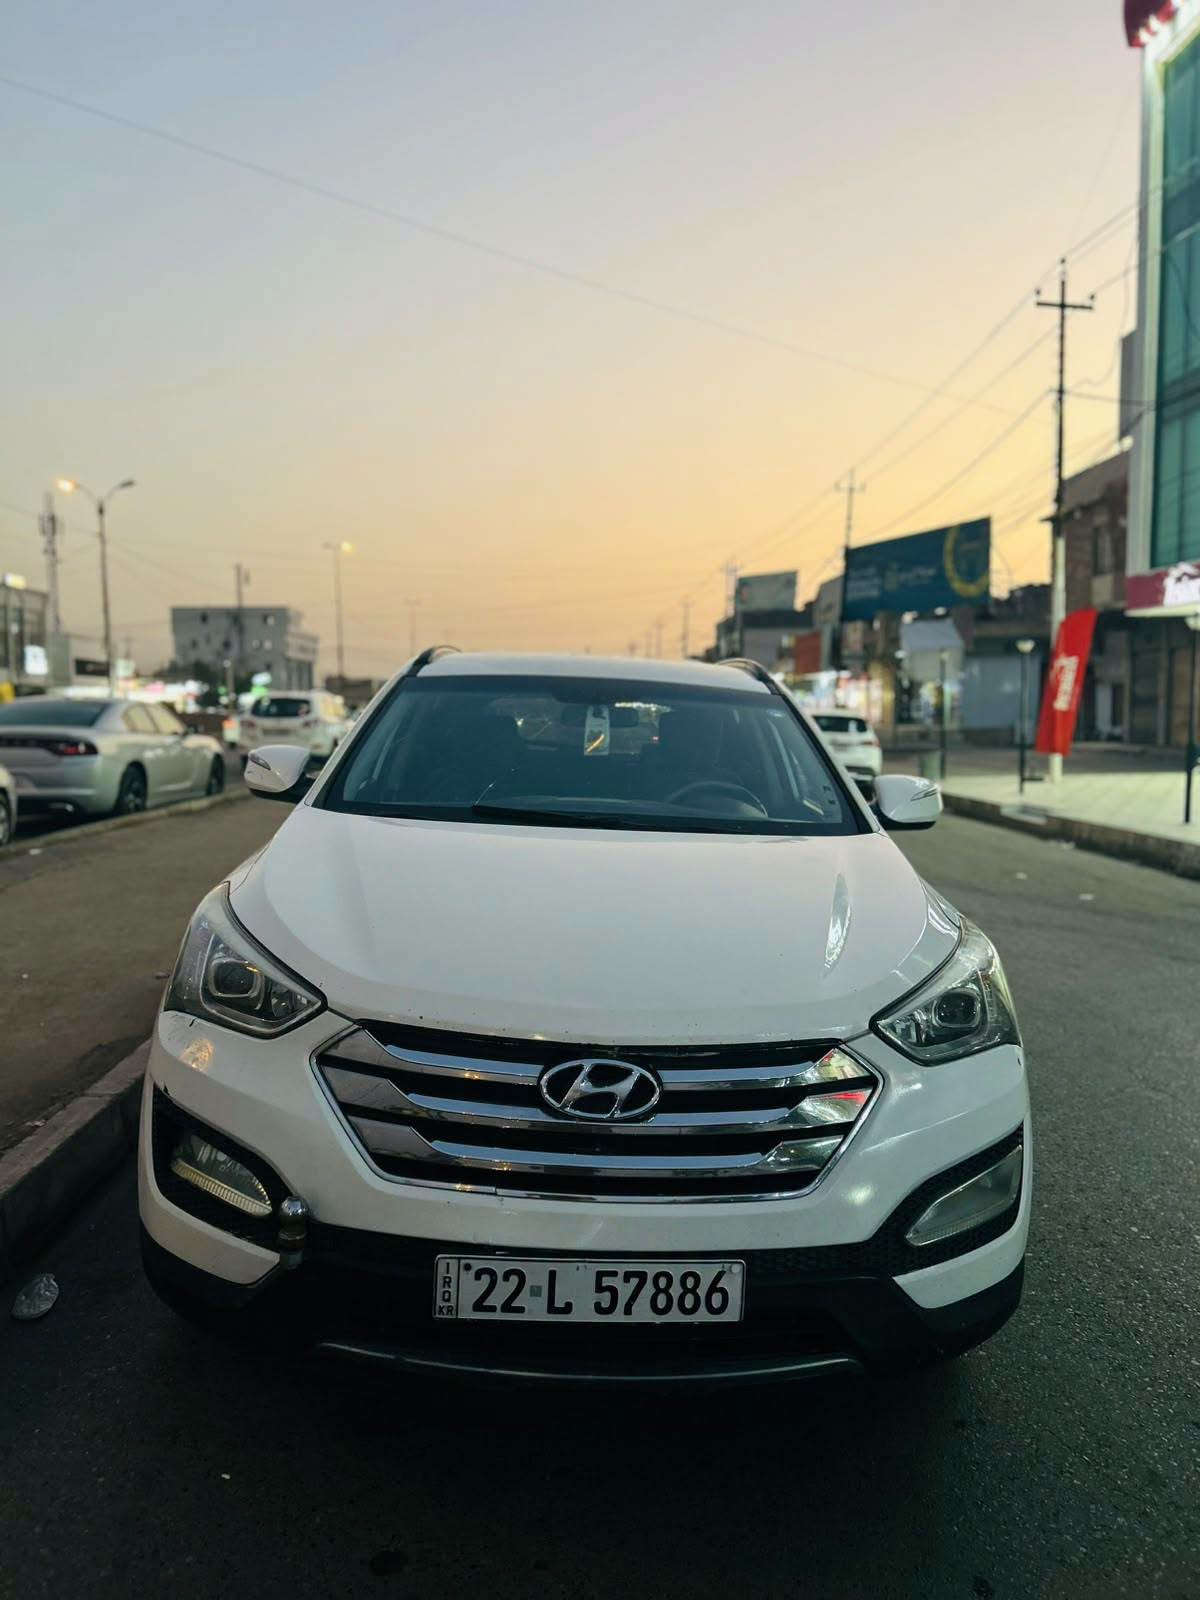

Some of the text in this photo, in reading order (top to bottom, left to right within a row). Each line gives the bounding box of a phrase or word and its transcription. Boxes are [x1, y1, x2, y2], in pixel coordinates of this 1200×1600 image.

[472, 1267, 730, 1317] 22 L 57886
[437, 1305, 455, 1316] KR
